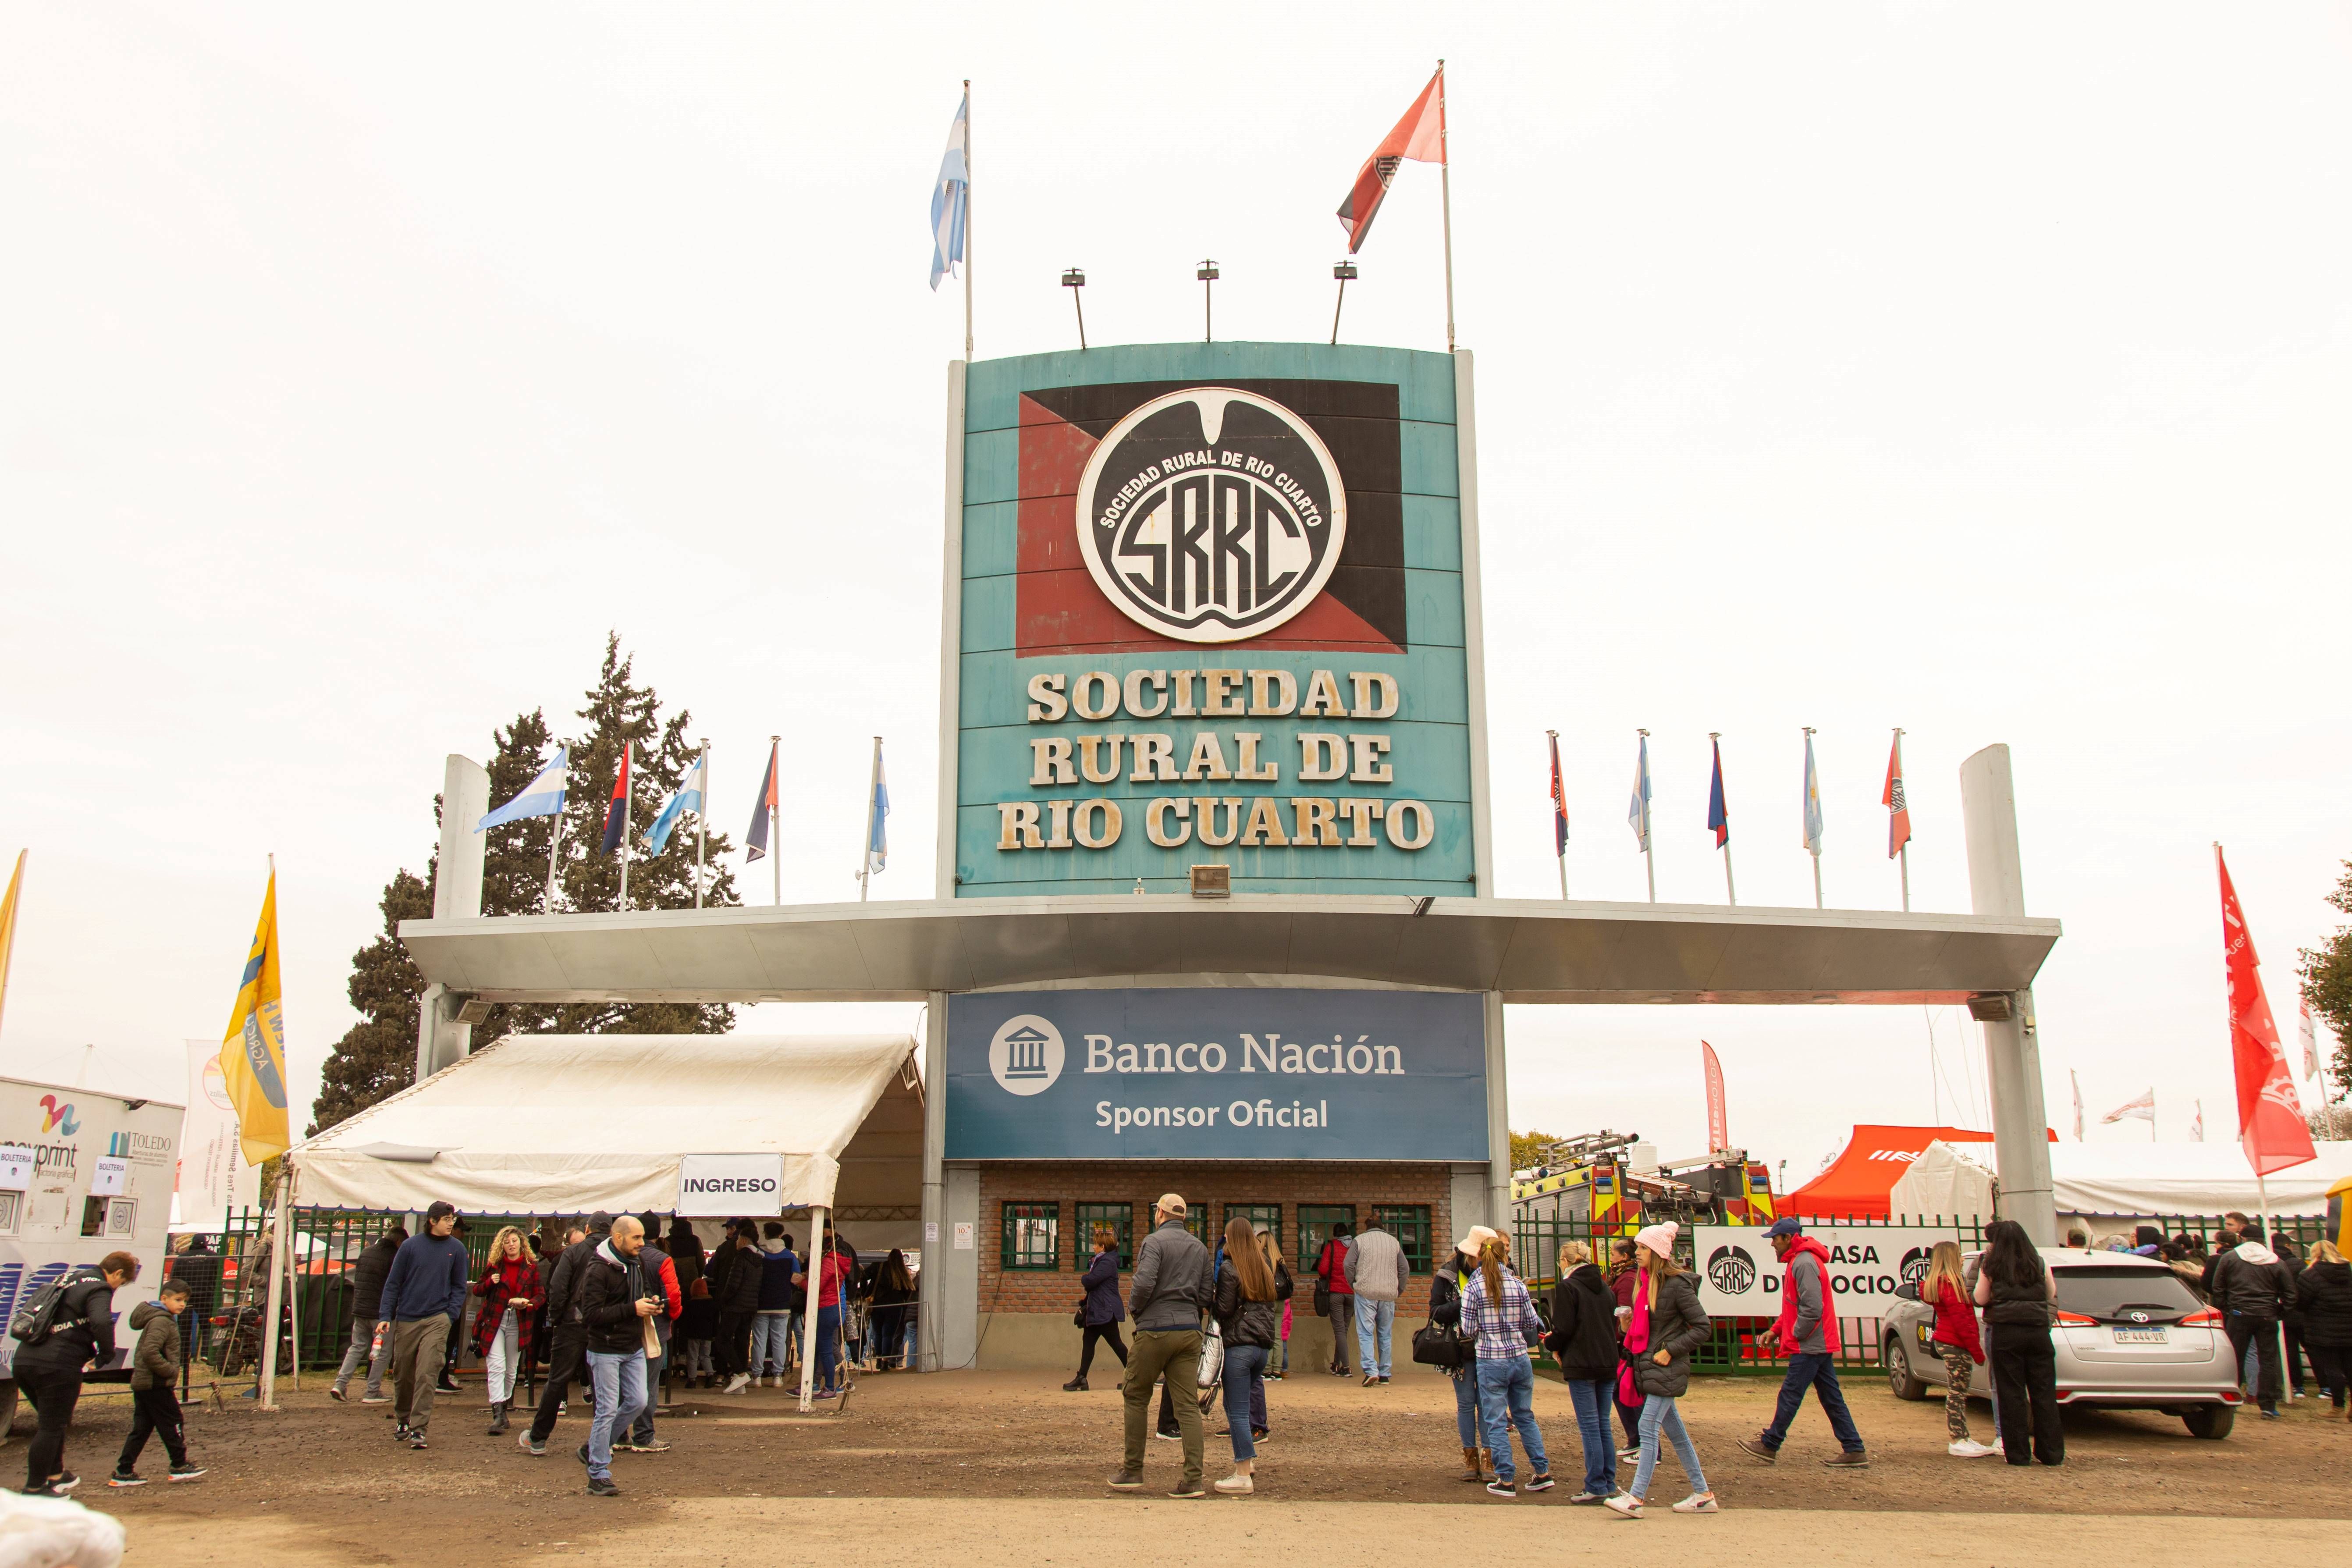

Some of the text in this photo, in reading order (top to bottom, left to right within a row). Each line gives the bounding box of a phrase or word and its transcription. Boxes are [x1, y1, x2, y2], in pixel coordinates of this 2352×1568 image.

[1100, 450, 1322, 529] SOCIEDAD RURAL DE RIO CUARTO
[1119, 475, 1300, 614] SRRC
[1027, 669, 1399, 723] SOCIEDAD
[1029, 732, 1393, 786] RURAL DE
[997, 796, 1434, 850] RIO CUARTO
[1084, 1034, 1405, 1074] Banco Nación
[1096, 1099, 1327, 1134] Sponsor Oficial
[132, 1132, 171, 1151] TOLEDO
[1, 1153, 32, 1163] BOLETERIA
[99, 1163, 124, 1172] BOLETERIA
[684, 1178, 776, 1192] INGRESO
[1823, 1245, 1880, 1264] ASA
[1709, 1259, 1722, 1273] SOCIEDAD
[1744, 1262, 1754, 1274] CUARTO
[1901, 1261, 1914, 1275] SOCIEDAD
[1713, 1262, 1750, 1291] SRRC
[1831, 1275, 1896, 1294] OCIO
[2117, 1332, 2166, 1341] AF 444 VR
